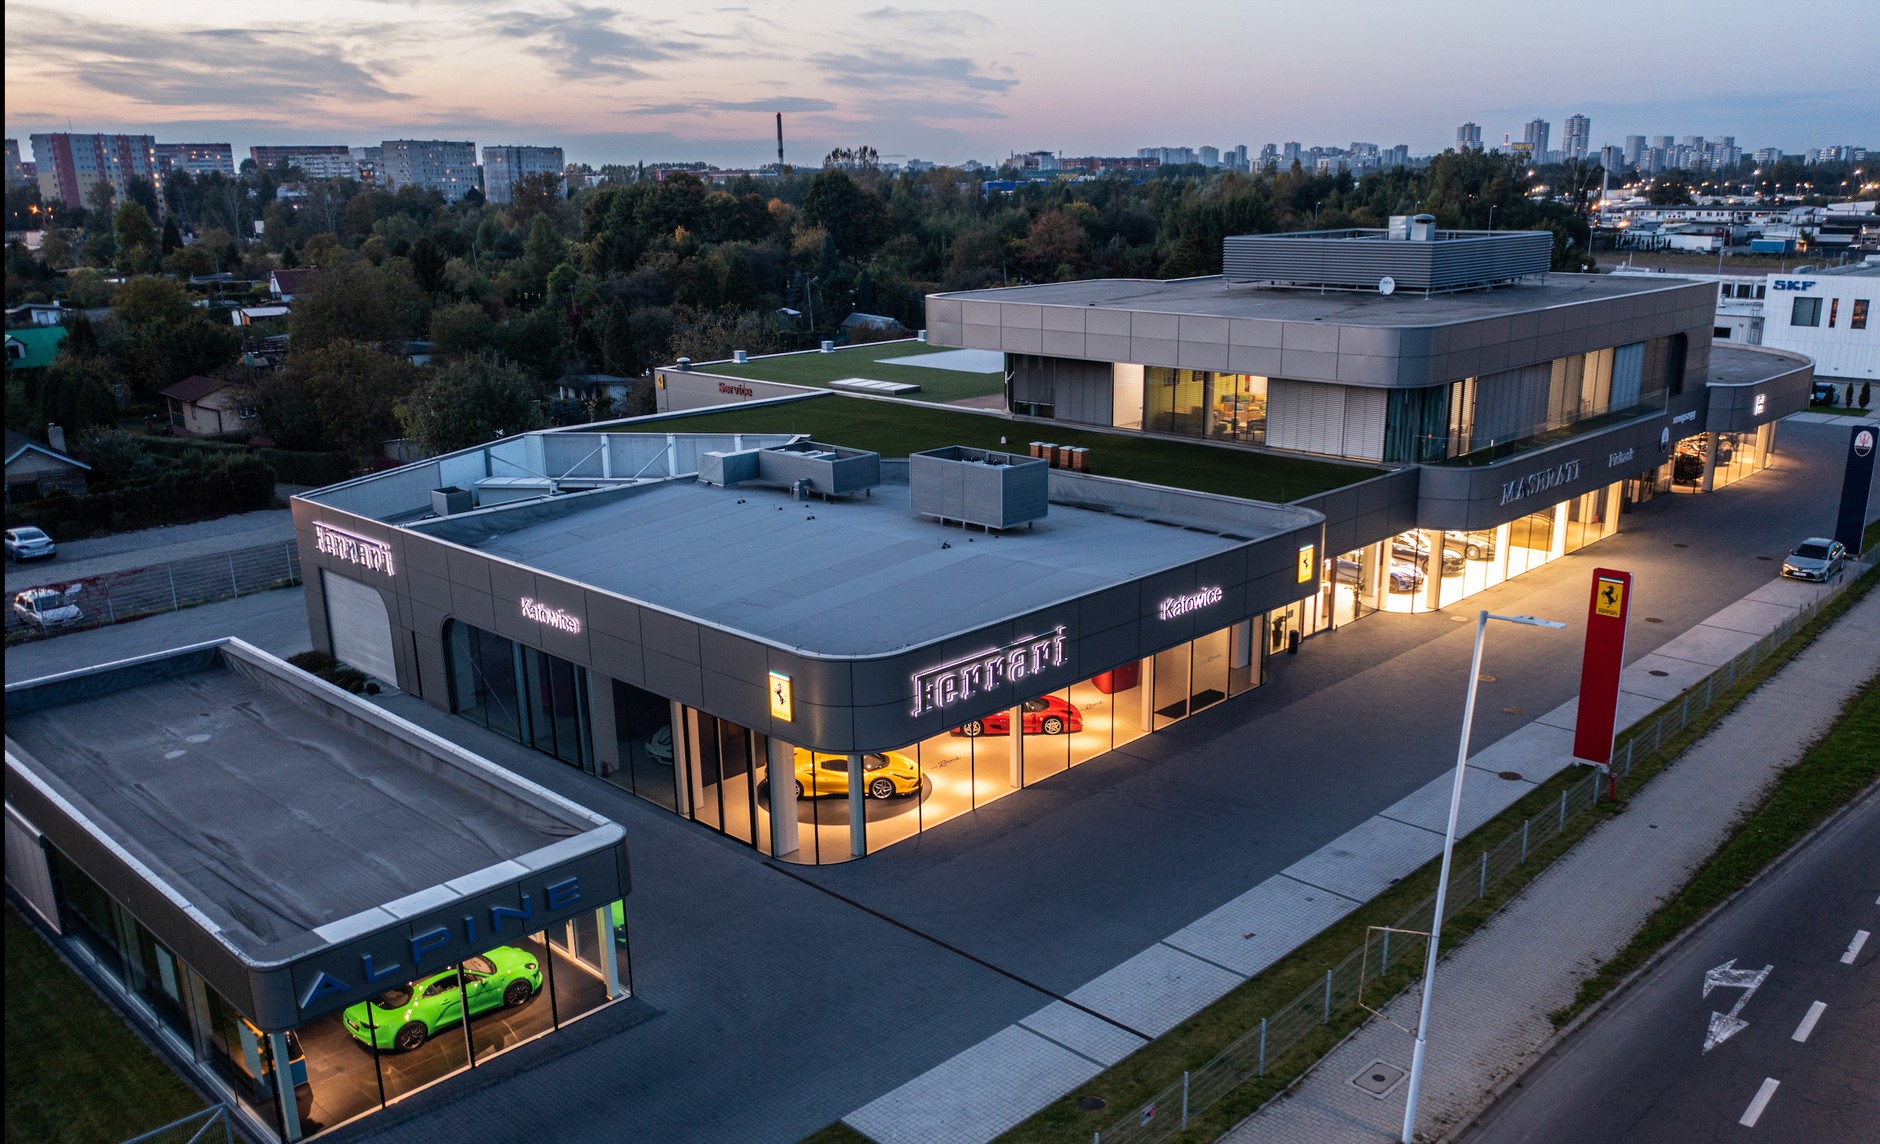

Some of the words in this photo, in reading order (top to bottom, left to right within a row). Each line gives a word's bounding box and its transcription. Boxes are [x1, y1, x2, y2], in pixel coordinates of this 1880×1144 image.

[1773, 280, 1816, 291] SKF
[718, 381, 753, 397] Service
[1500, 459, 1581, 506] MASERATI
[312, 521, 396, 577] Ferrari
[520, 597, 580, 634] Katowice
[1159, 586, 1223, 621] Katowice
[912, 625, 1067, 718] Ferrari
[300, 876, 580, 1010] ALPINE
